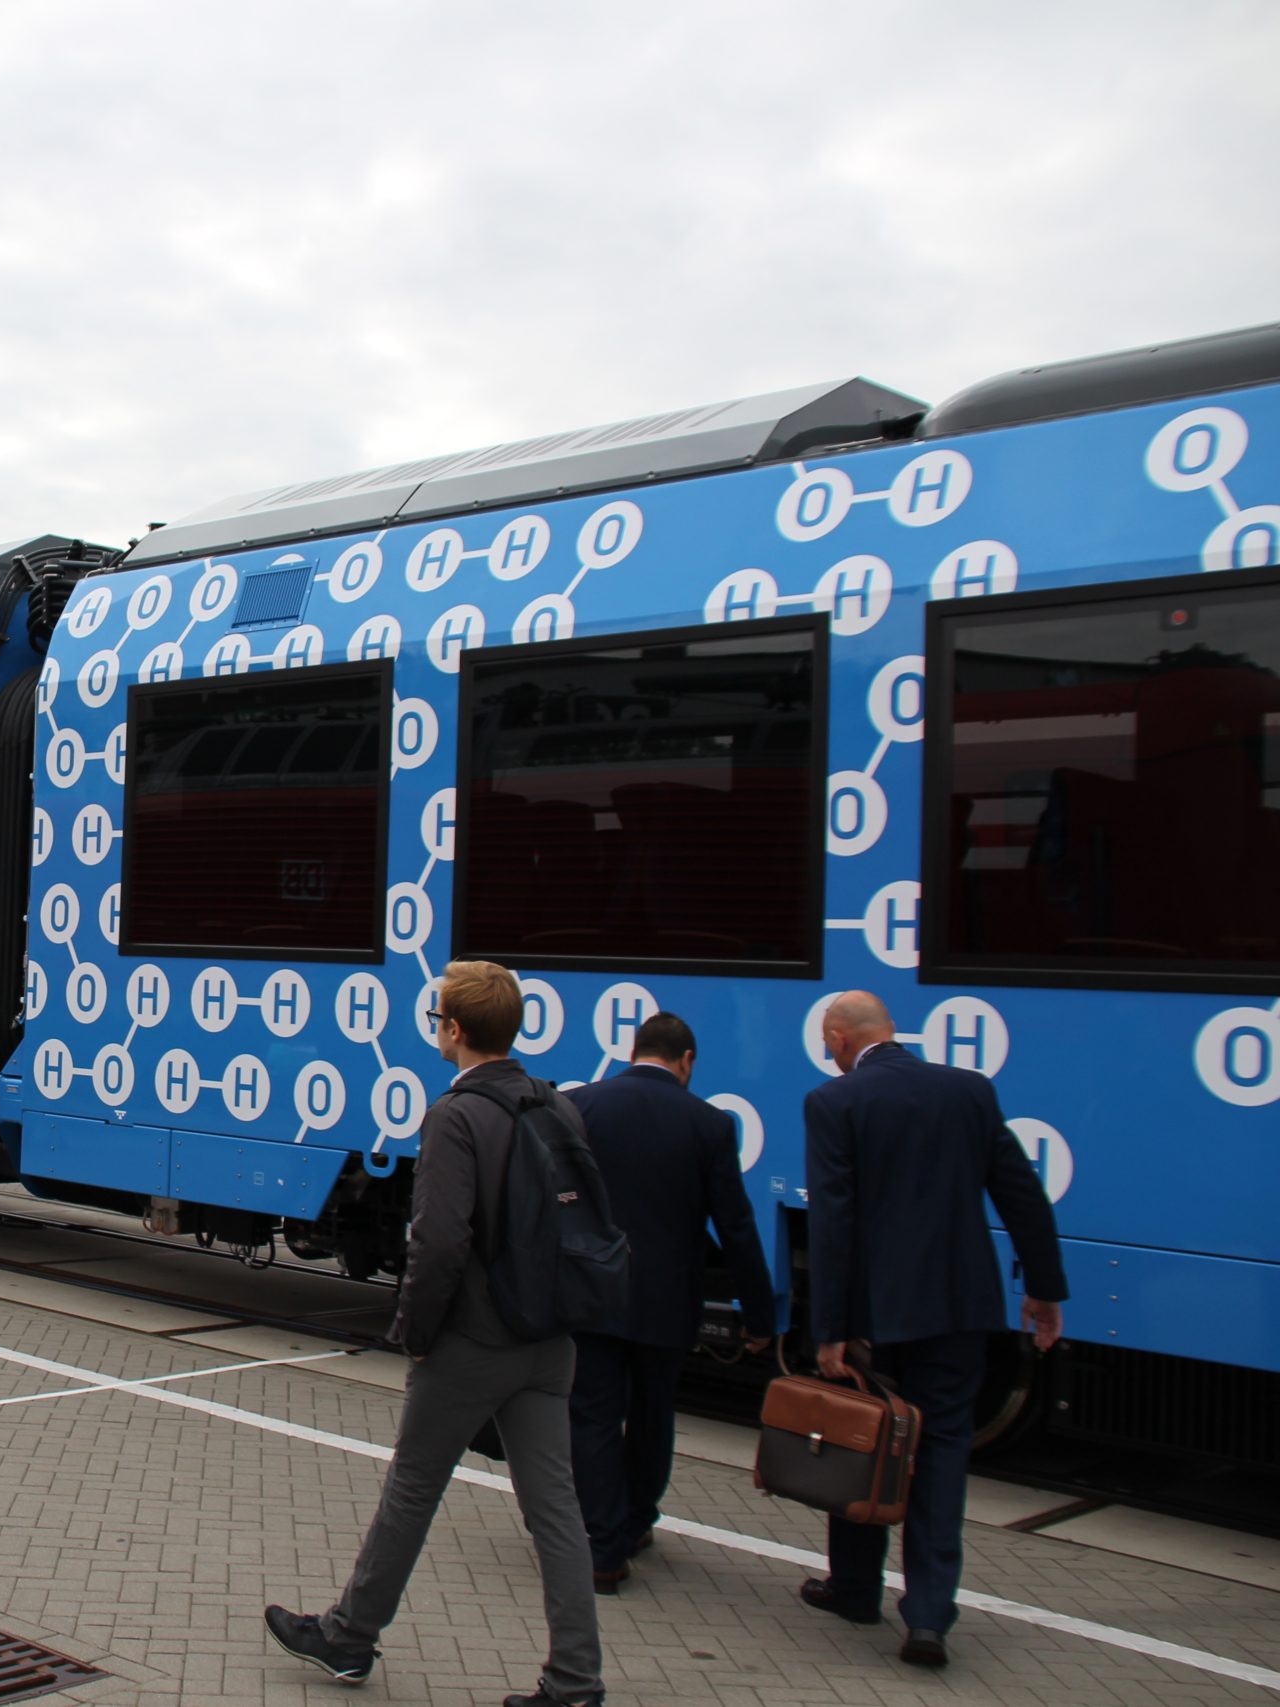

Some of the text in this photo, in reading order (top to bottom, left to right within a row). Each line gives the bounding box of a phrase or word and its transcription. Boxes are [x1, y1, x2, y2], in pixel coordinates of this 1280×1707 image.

[1174, 424, 1219, 474] O
[798, 483, 832, 527] O
[910, 464, 951, 512] H
[503, 528, 535, 567] H
[595, 514, 625, 555] O
[1232, 523, 1280, 570] O
[343, 554, 368, 590] O
[419, 541, 450, 579] H
[953, 555, 995, 599] H
[76, 596, 104, 628] H
[138, 585, 161, 619] O
[202, 576, 225, 609] O
[725, 583, 760, 623] H
[834, 570, 873, 619] H
[361, 628, 388, 660] H
[442, 618, 471, 659] H
[529, 607, 558, 643] O
[150, 655, 172, 684] H
[216, 646, 239, 676] H
[286, 637, 311, 669] H
[89, 667, 108, 696] O
[891, 672, 924, 725] O
[399, 712, 423, 755] O
[57, 740, 74, 776] O
[830, 787, 865, 839] O
[83, 816, 101, 852] H
[51, 896, 69, 932] O
[393, 896, 417, 940] O
[887, 898, 920, 951] H
[77, 975, 96, 1012] O
[138, 977, 158, 1015] H
[204, 980, 225, 1019] H
[274, 983, 297, 1024] H
[349, 987, 375, 1029] H
[521, 993, 547, 1040] O
[612, 999, 643, 1045] H
[944, 1014, 985, 1069] H
[1225, 1026, 1272, 1087] O
[44, 1051, 62, 1088] H
[104, 1056, 123, 1094] O
[167, 1062, 188, 1101] H
[235, 1068, 257, 1108] H
[308, 1074, 332, 1117] O
[386, 1081, 411, 1125] O
